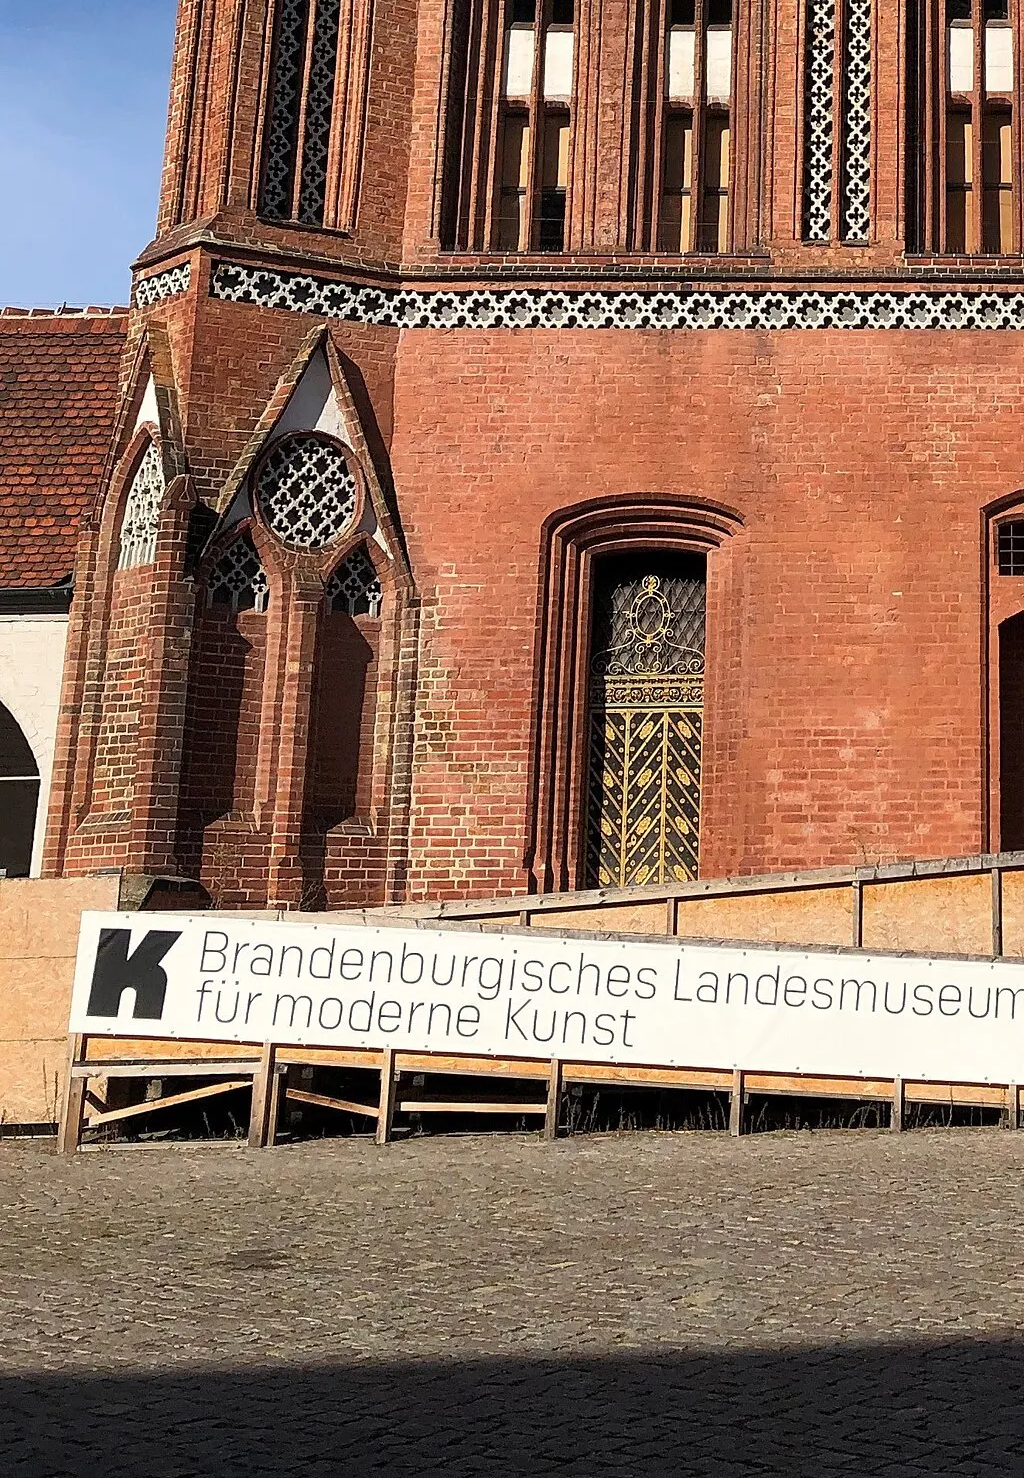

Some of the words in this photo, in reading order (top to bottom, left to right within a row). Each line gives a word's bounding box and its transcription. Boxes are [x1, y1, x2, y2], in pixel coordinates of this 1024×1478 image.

[86, 928, 183, 1020] K
[200, 931, 657, 1000] Brandenburgisches
[197, 980, 262, 1023] für
[273, 991, 480, 1037] moderne
[504, 998, 636, 1047] Kunst
